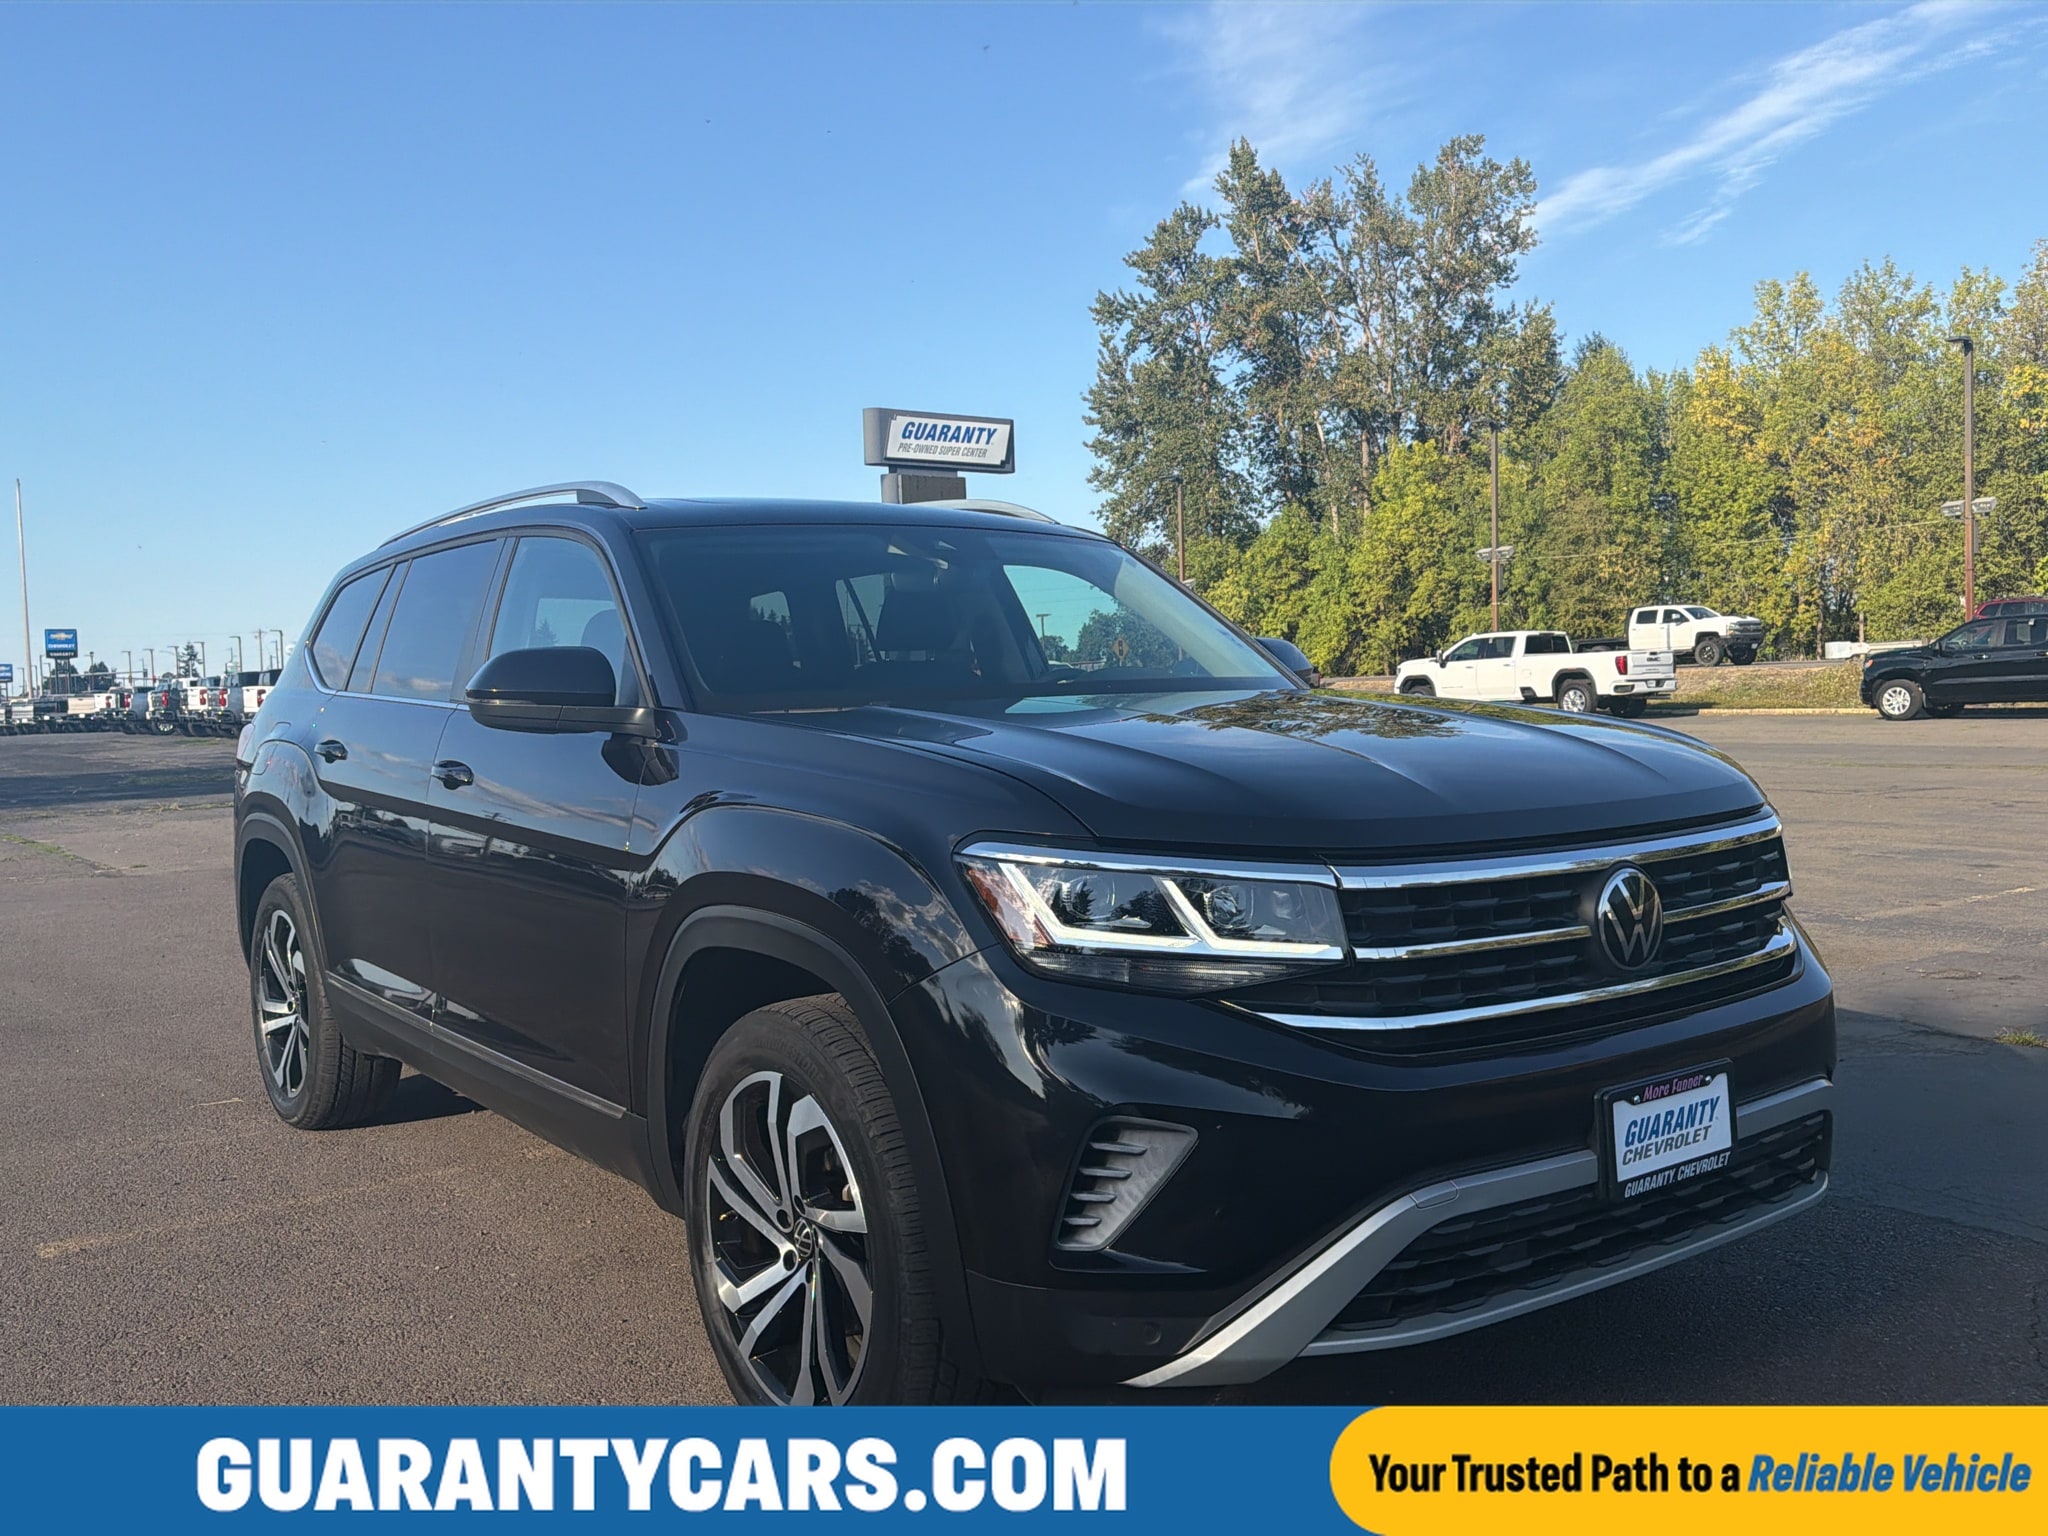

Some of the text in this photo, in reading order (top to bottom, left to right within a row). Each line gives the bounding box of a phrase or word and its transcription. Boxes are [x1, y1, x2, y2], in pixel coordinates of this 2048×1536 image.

[901, 421, 997, 445] GUARANTY
[897, 442, 988, 459] PRE-OWNED SUPER CENTER
[1643, 1083, 1670, 1101] More
[1624, 1096, 1720, 1148] GUARANTY
[1622, 1125, 1712, 1166] CHEVROLET
[1677, 1151, 1731, 1181] CHEVROLET
